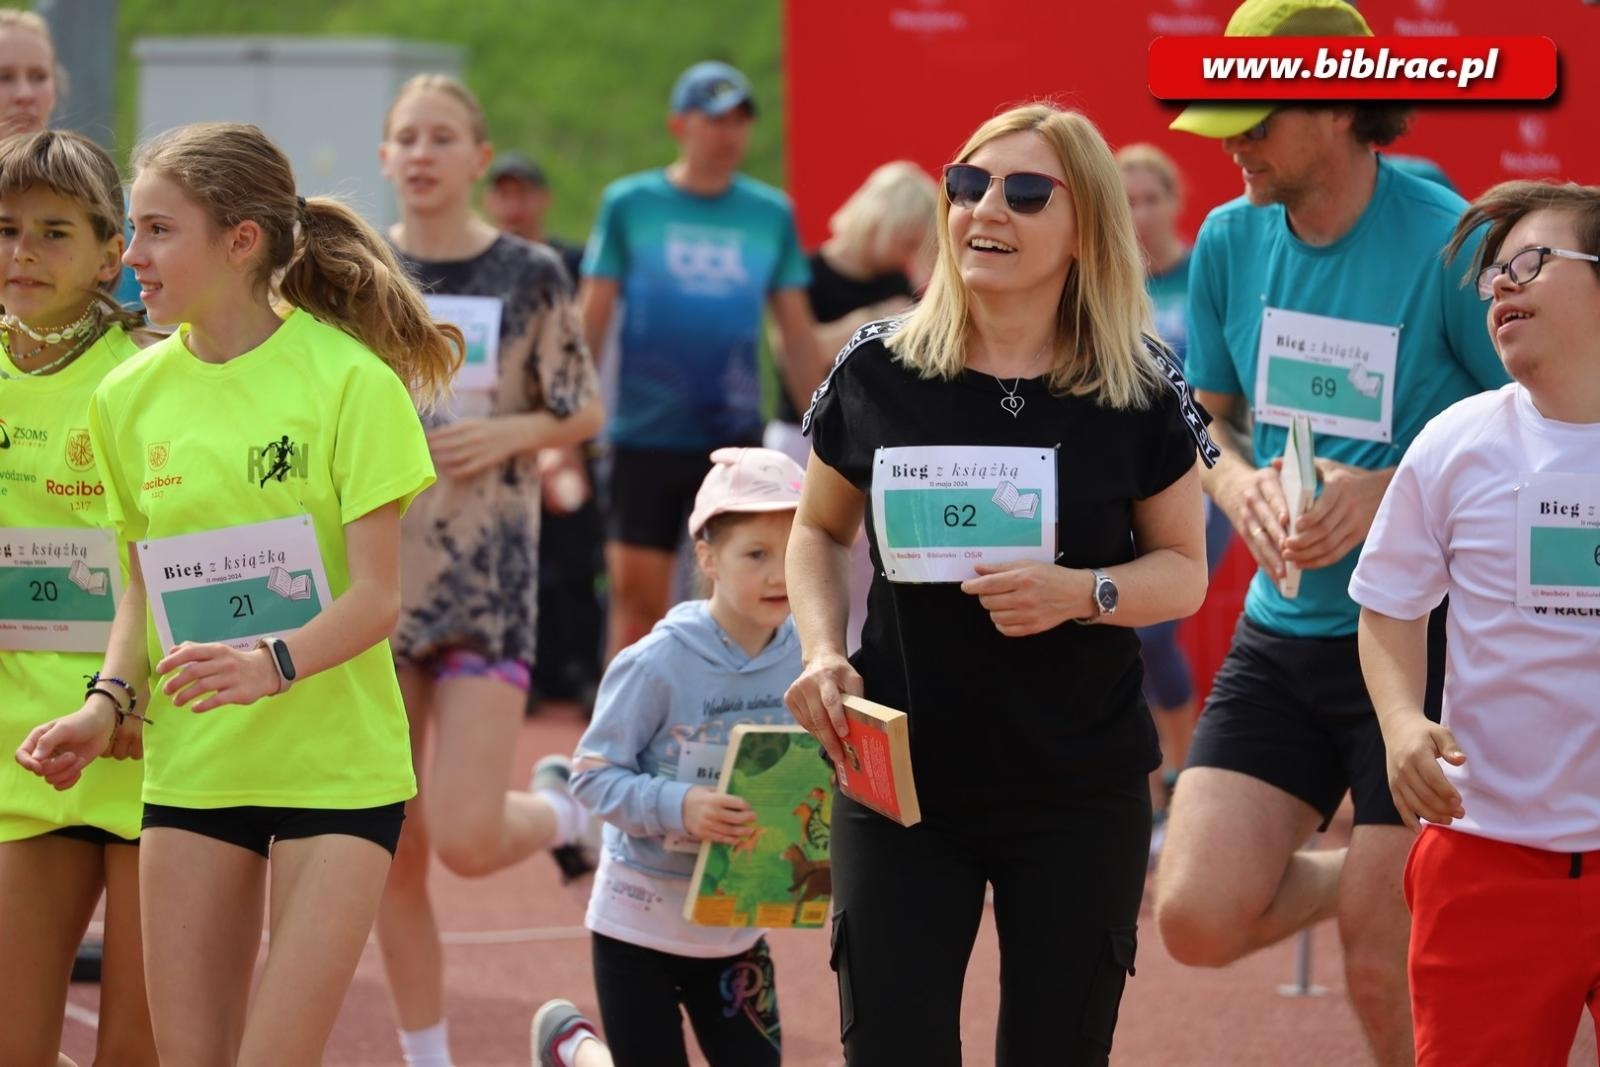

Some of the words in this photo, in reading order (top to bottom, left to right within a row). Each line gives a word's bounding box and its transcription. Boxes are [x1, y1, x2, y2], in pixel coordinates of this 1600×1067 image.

[1311, 376, 1337, 398] 69
[892, 464, 929, 480] Bieg
[936, 467, 944, 477] z
[952, 463, 1019, 480] książką
[46, 479, 105, 496] Racibó
[143, 474, 183, 490] acibórz
[943, 504, 977, 527] 62
[1540, 501, 1580, 518] Bieg
[32, 542, 87, 559] książką
[164, 562, 204, 580] Bieg
[224, 550, 286, 571] książką
[30, 581, 58, 602] 20
[229, 594, 255, 618] 21
[697, 767, 721, 780] Bie
